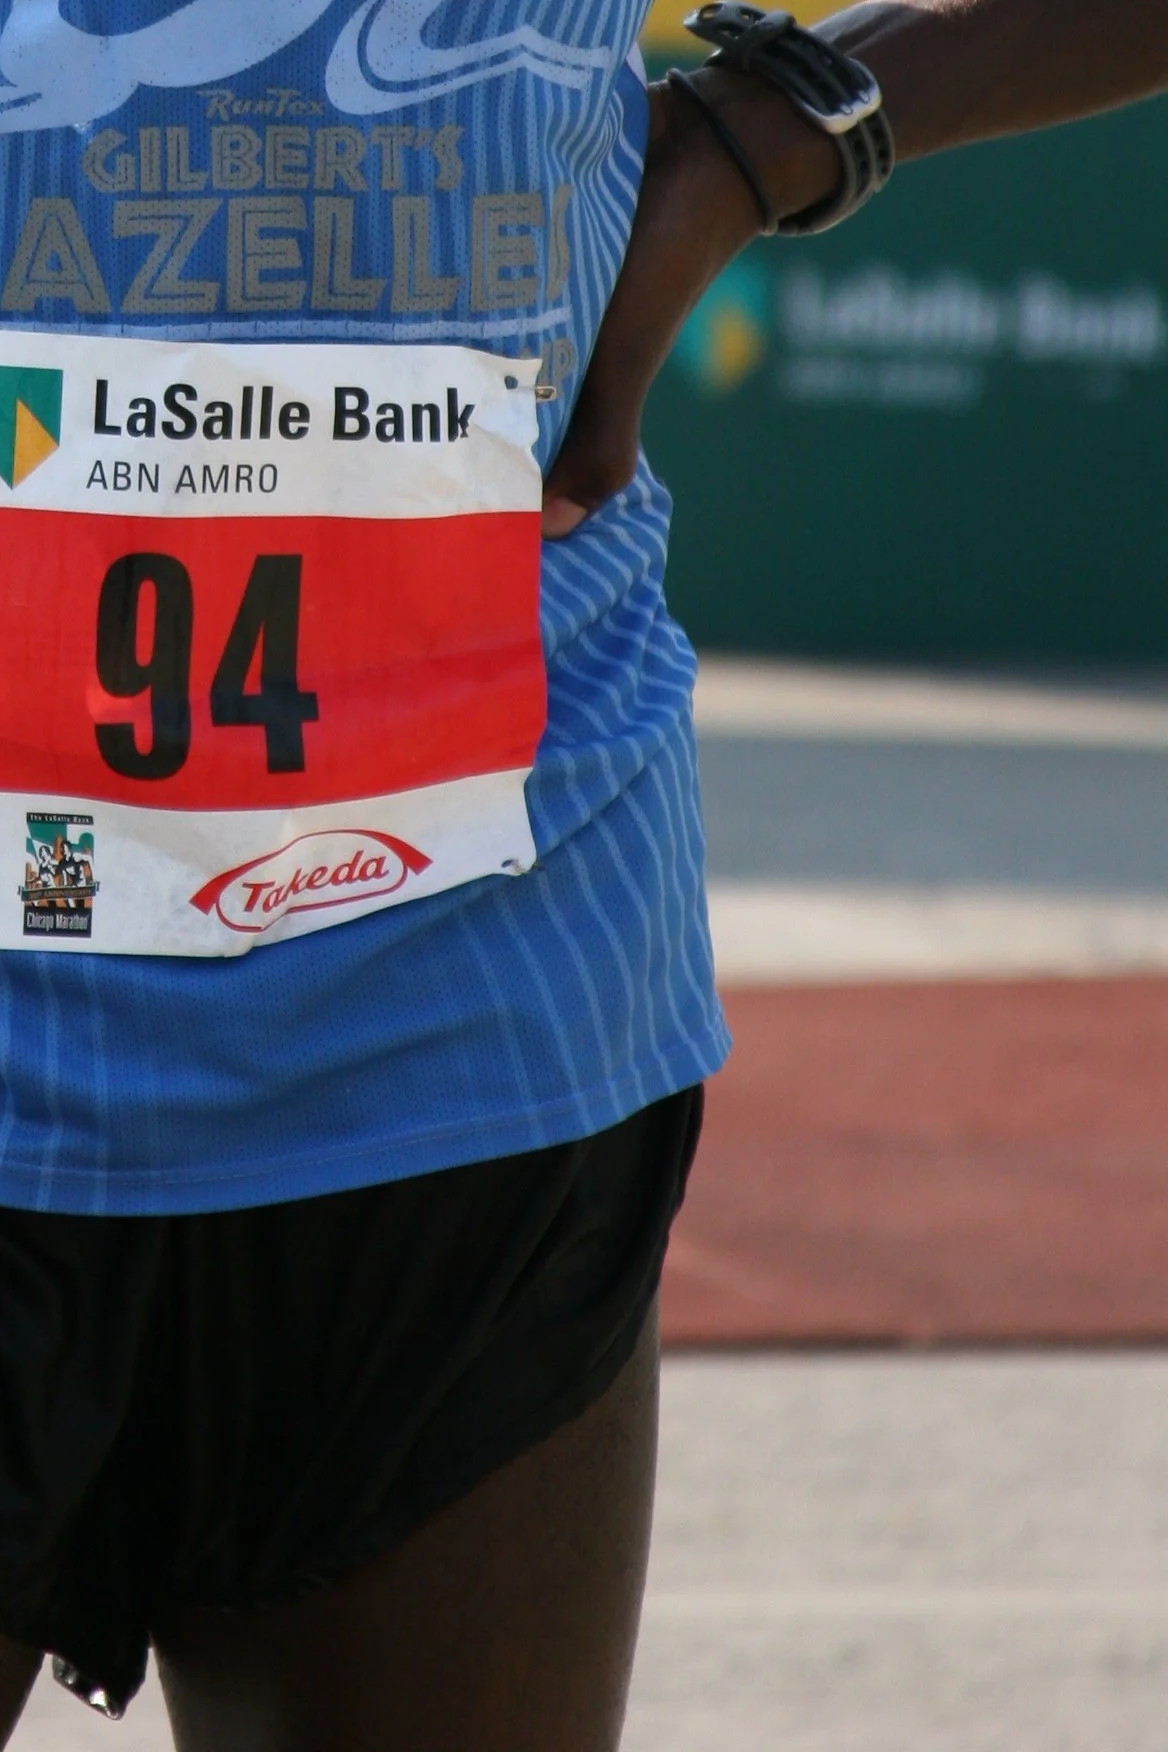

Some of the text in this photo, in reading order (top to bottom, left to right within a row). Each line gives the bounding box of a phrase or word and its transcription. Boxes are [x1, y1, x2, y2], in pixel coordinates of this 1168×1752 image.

[196, 87, 326, 121] RunTex
[82, 123, 465, 193] GILBERT'S
[93, 378, 476, 444] LaSalle Bank
[85, 459, 279, 495] ABN AMRO
[93, 552, 320, 782] 94
[242, 850, 390, 914] Takeda
[27, 912, 54, 932] Chicago
